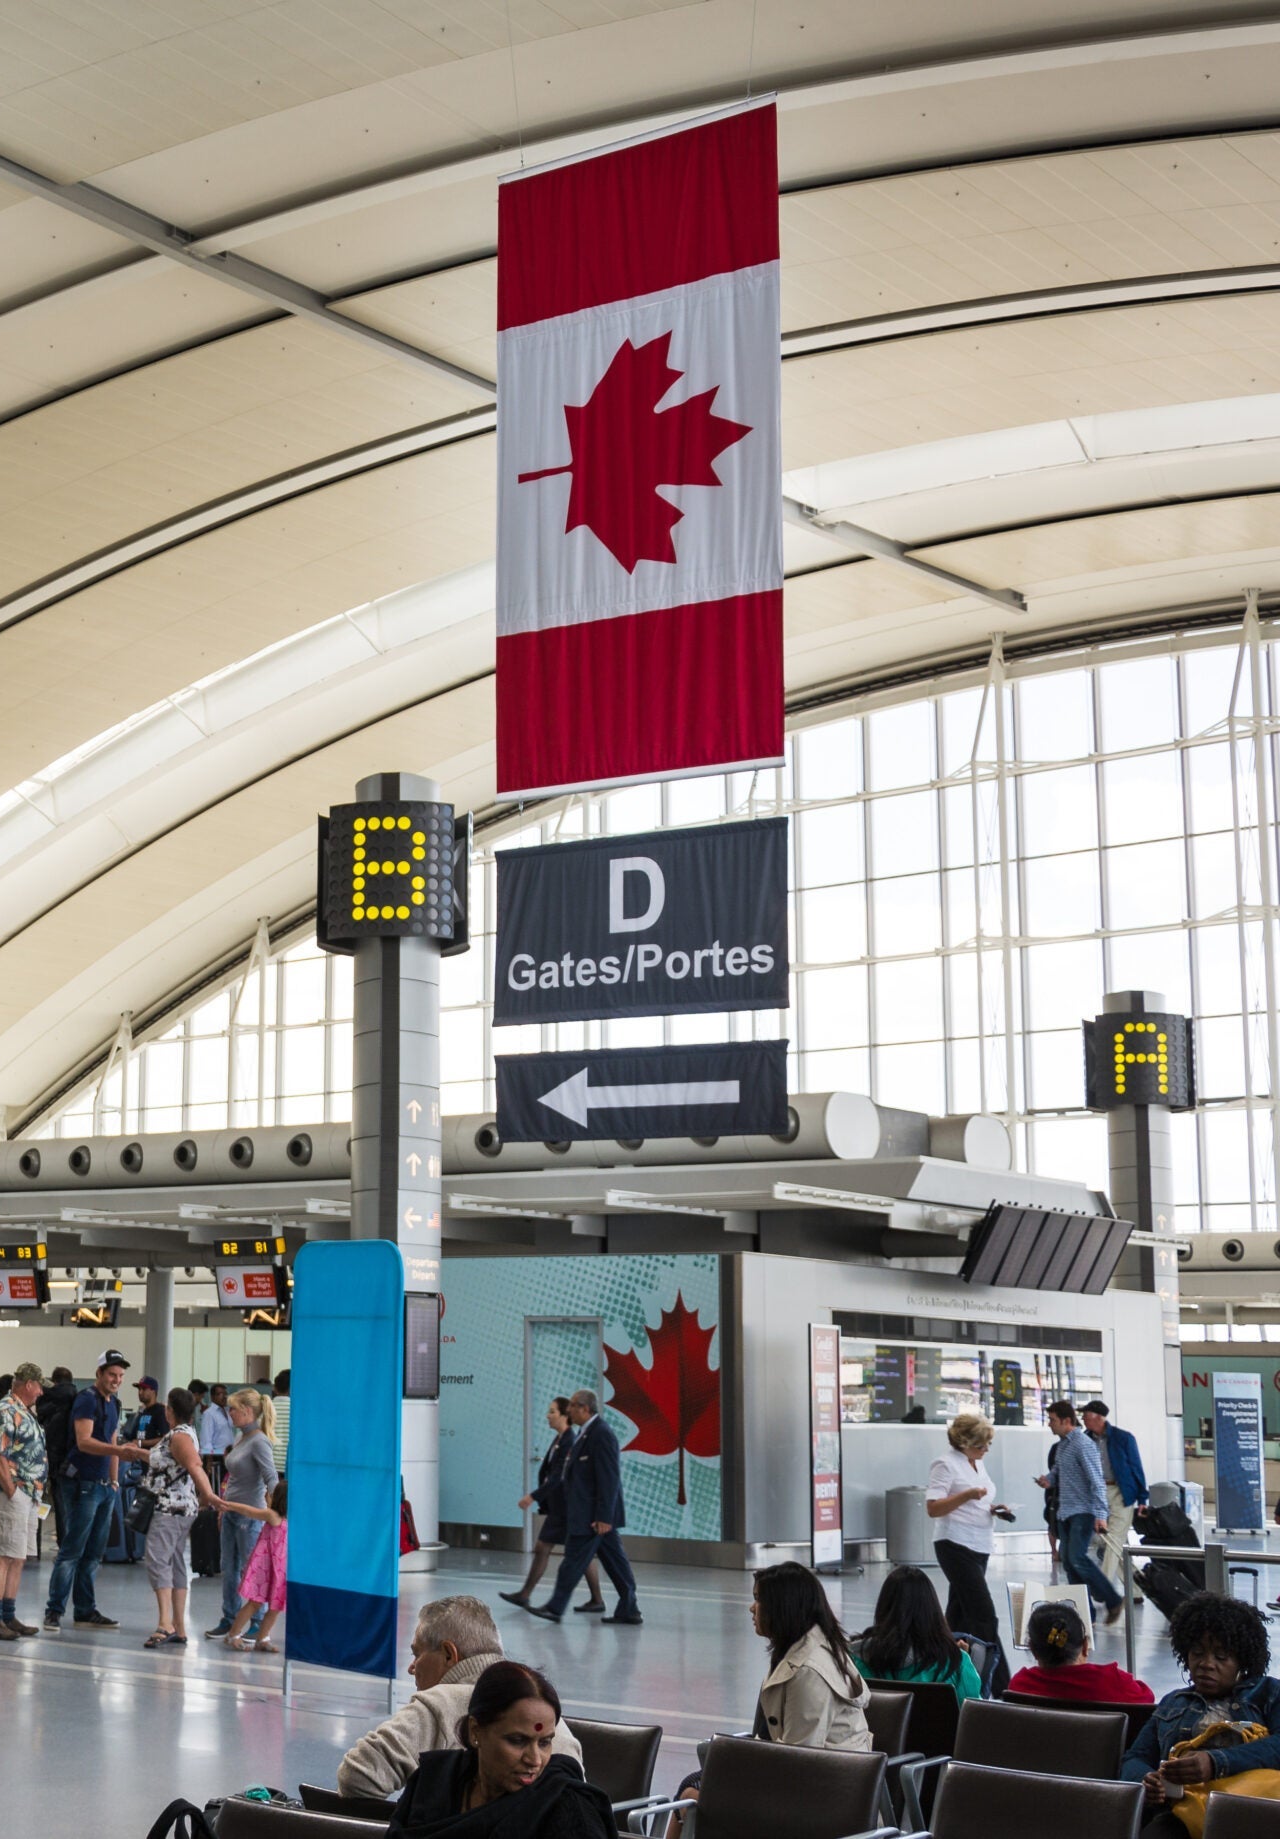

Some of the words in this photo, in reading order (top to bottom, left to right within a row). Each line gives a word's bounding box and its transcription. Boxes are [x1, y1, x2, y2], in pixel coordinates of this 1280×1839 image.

[352, 814, 426, 922] B
[608, 856, 666, 933] D
[506, 939, 775, 992] Gates/Portes
[1113, 1022, 1169, 1095] A
[440, 1335, 457, 1343] DA
[441, 1374, 474, 1385] ement
